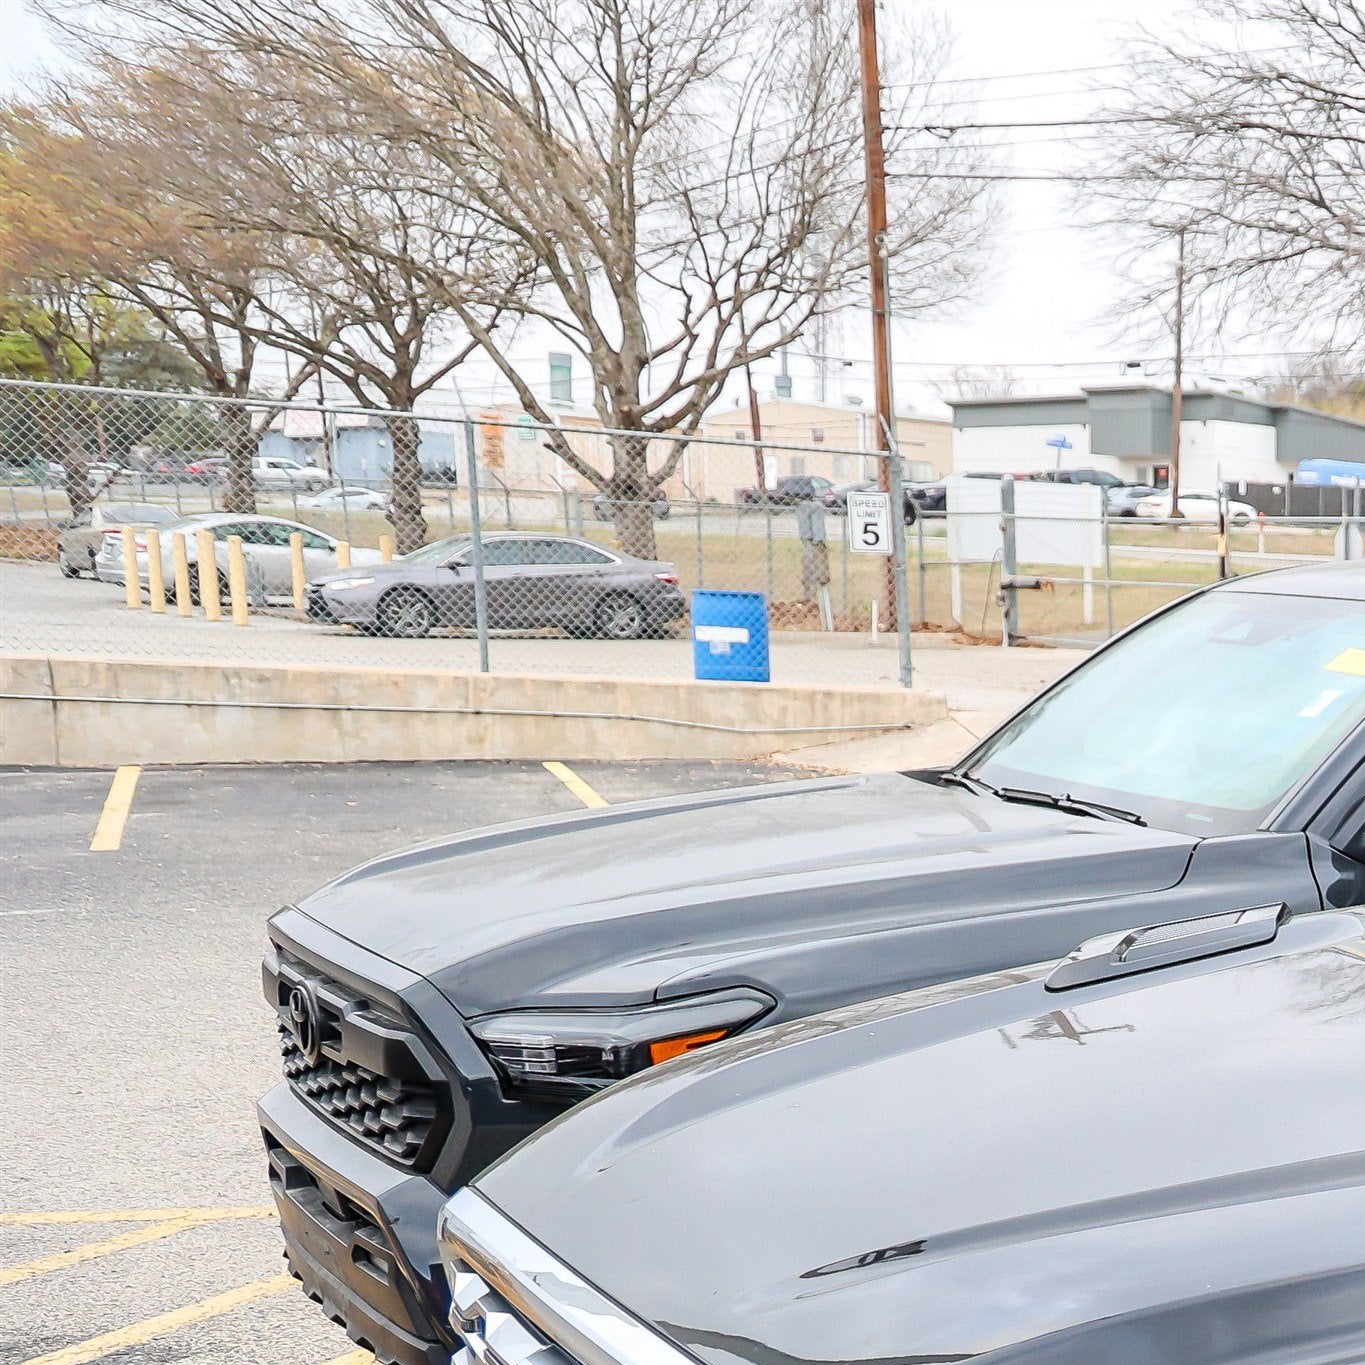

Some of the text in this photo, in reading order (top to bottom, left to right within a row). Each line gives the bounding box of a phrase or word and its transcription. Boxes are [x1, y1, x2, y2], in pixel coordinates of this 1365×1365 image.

[852, 500, 884, 508] SPEED
[857, 510, 881, 518] LIMIT
[863, 521, 880, 546] 5
